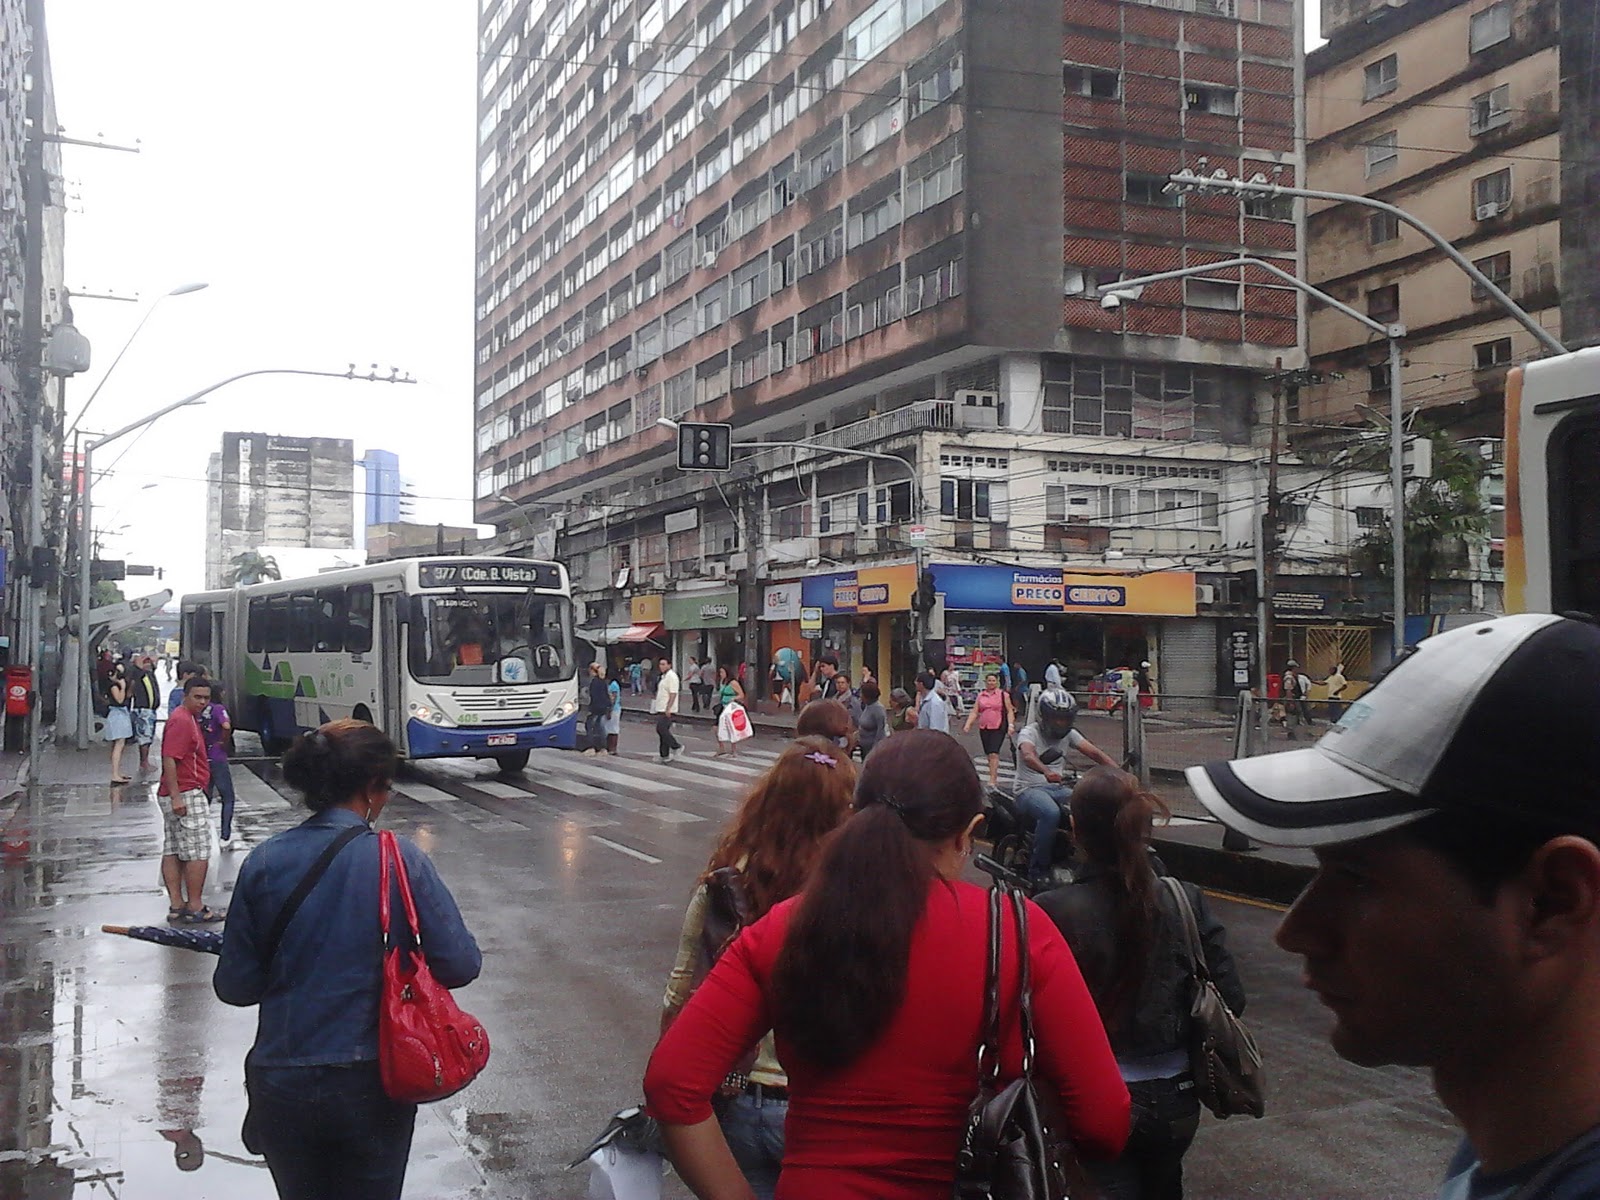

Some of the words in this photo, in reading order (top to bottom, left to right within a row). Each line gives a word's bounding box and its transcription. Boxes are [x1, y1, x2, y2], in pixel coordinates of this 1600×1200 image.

[1013, 573, 1063, 584] Farmácias
[1016, 588, 1062, 601] PREÇO
[1069, 588, 1120, 603] CERTO
[129, 598, 152, 612] B2
[457, 713, 479, 723] 405
